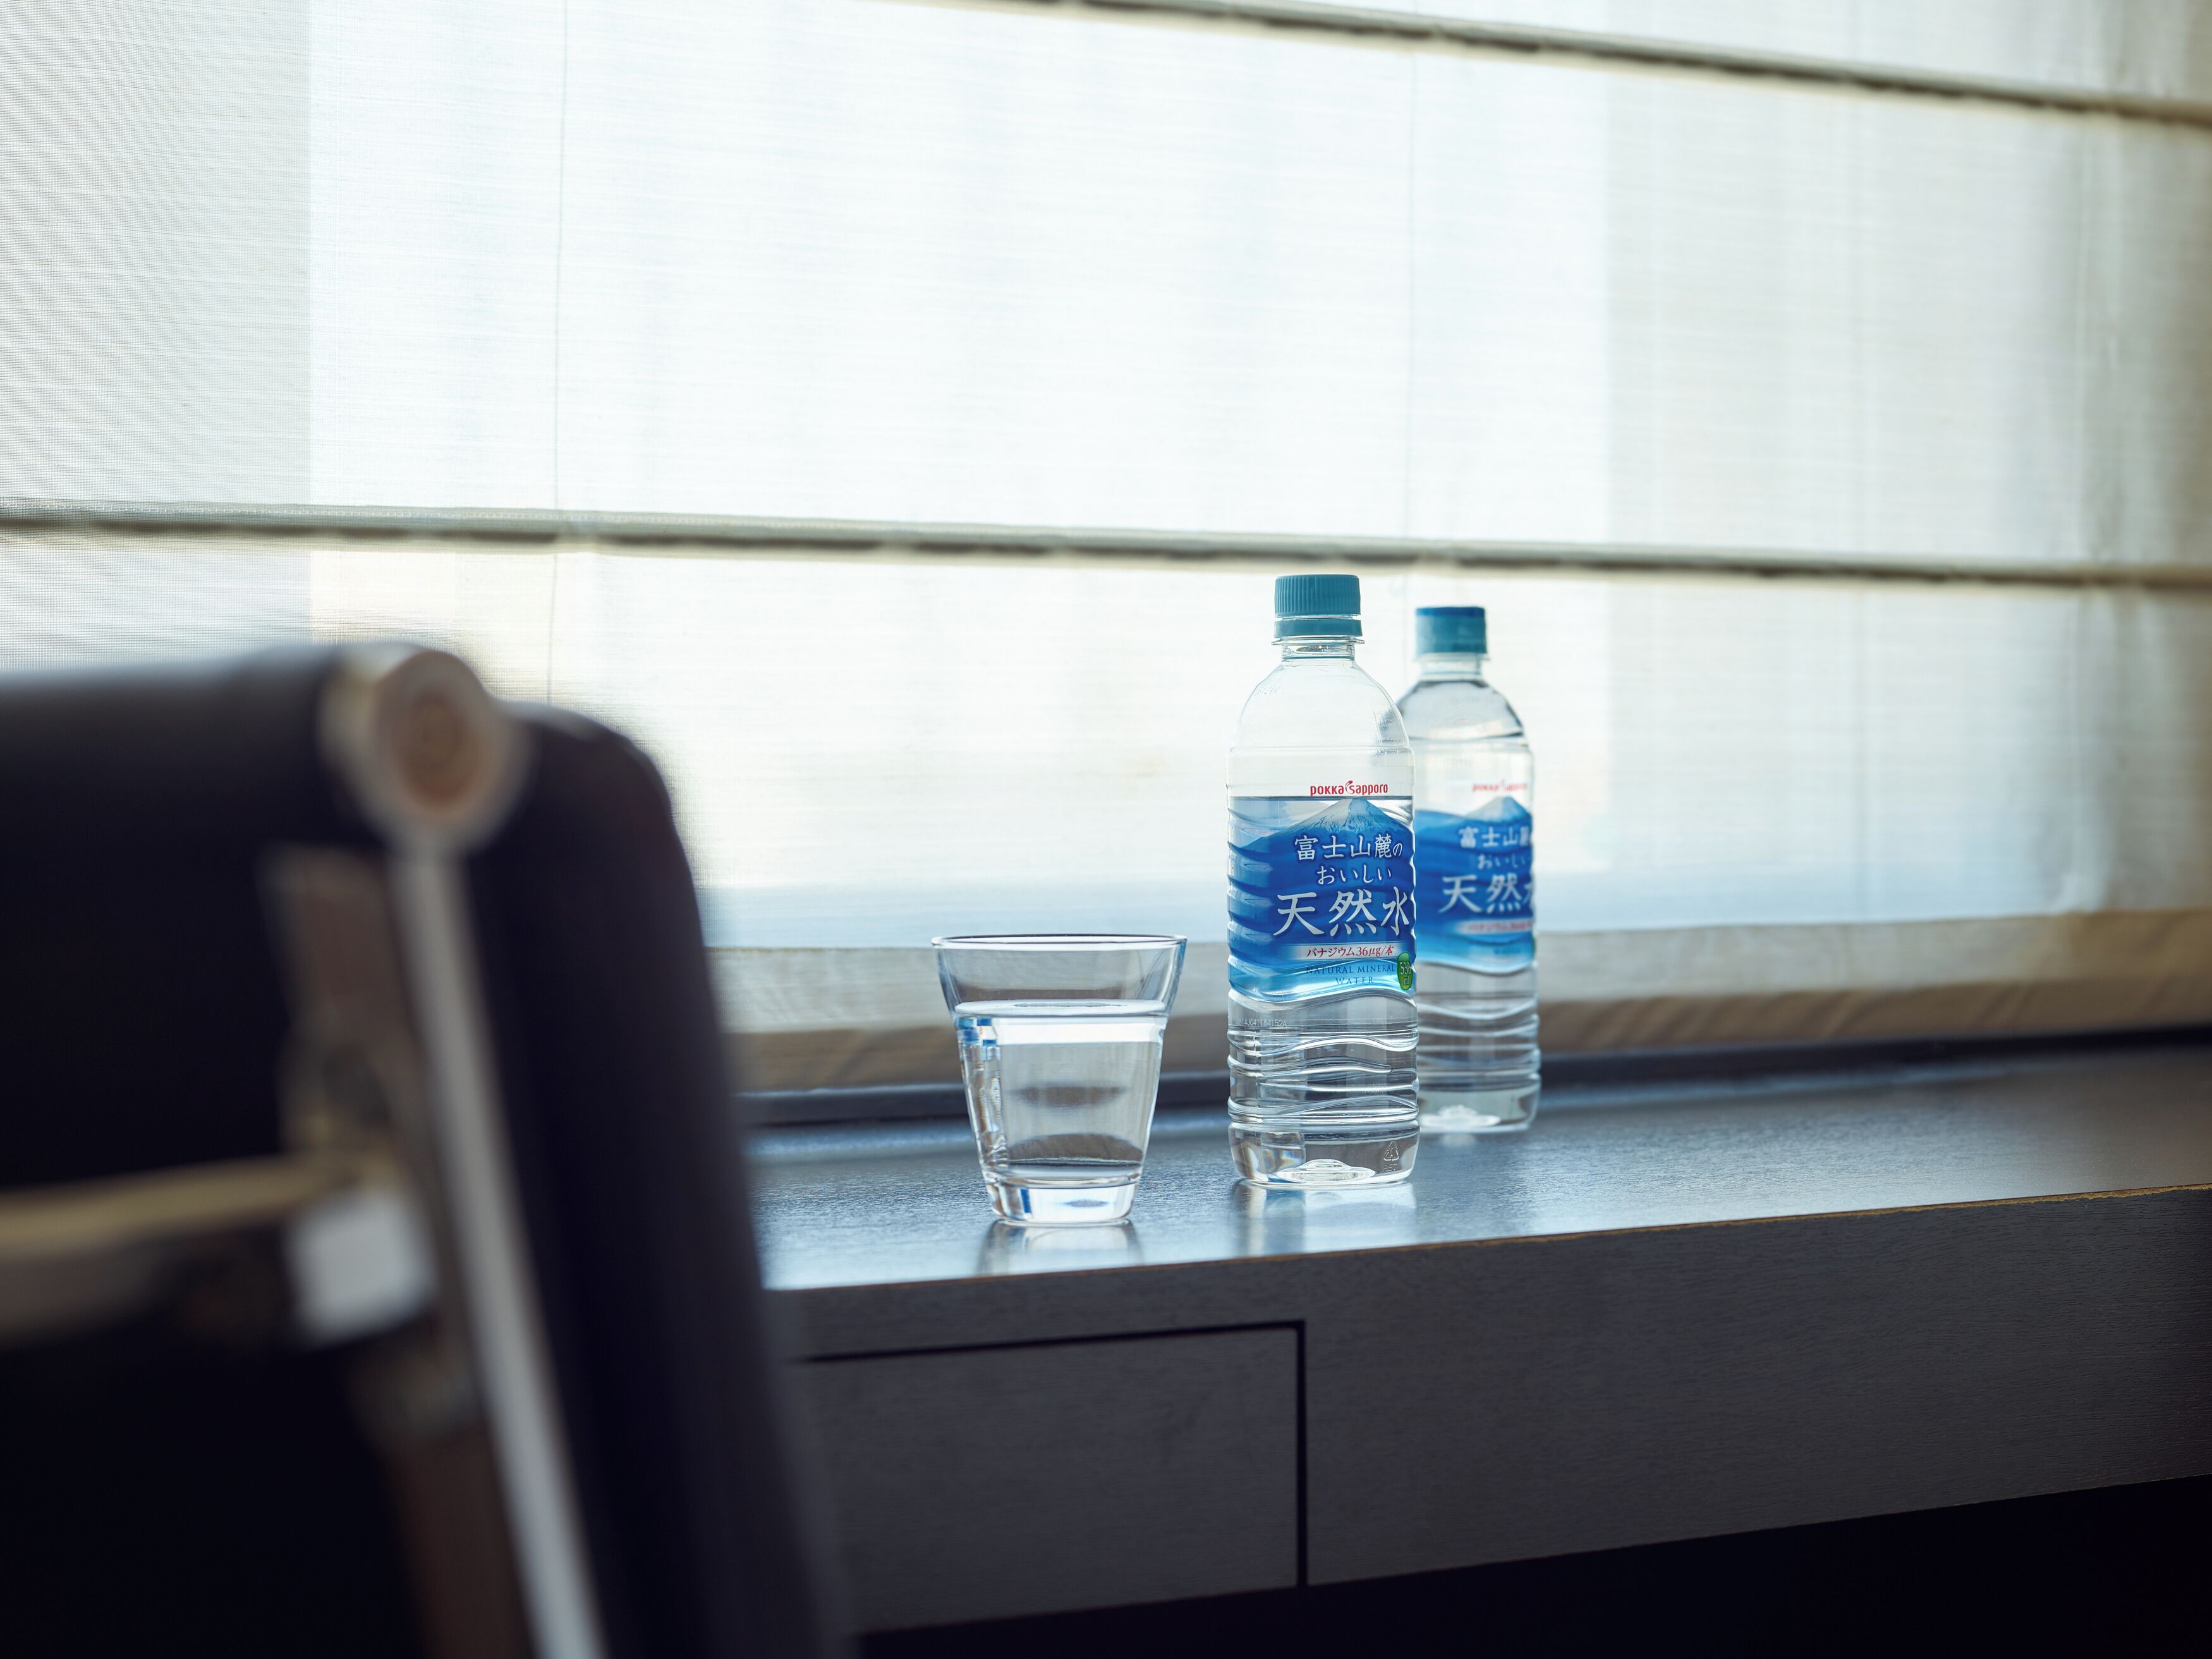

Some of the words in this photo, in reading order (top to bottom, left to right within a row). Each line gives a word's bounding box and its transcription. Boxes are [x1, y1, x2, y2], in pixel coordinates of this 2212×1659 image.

[1295, 833, 1403, 861] 富士山麓の
[1317, 864, 1392, 884] おいしい
[1273, 885, 1410, 937] 天然水
[1306, 966, 1354, 974] NATURAL
[1357, 964, 1395, 973] MINERAL
[1399, 961, 1412, 975] 530
[1335, 976, 1373, 985] WATER
